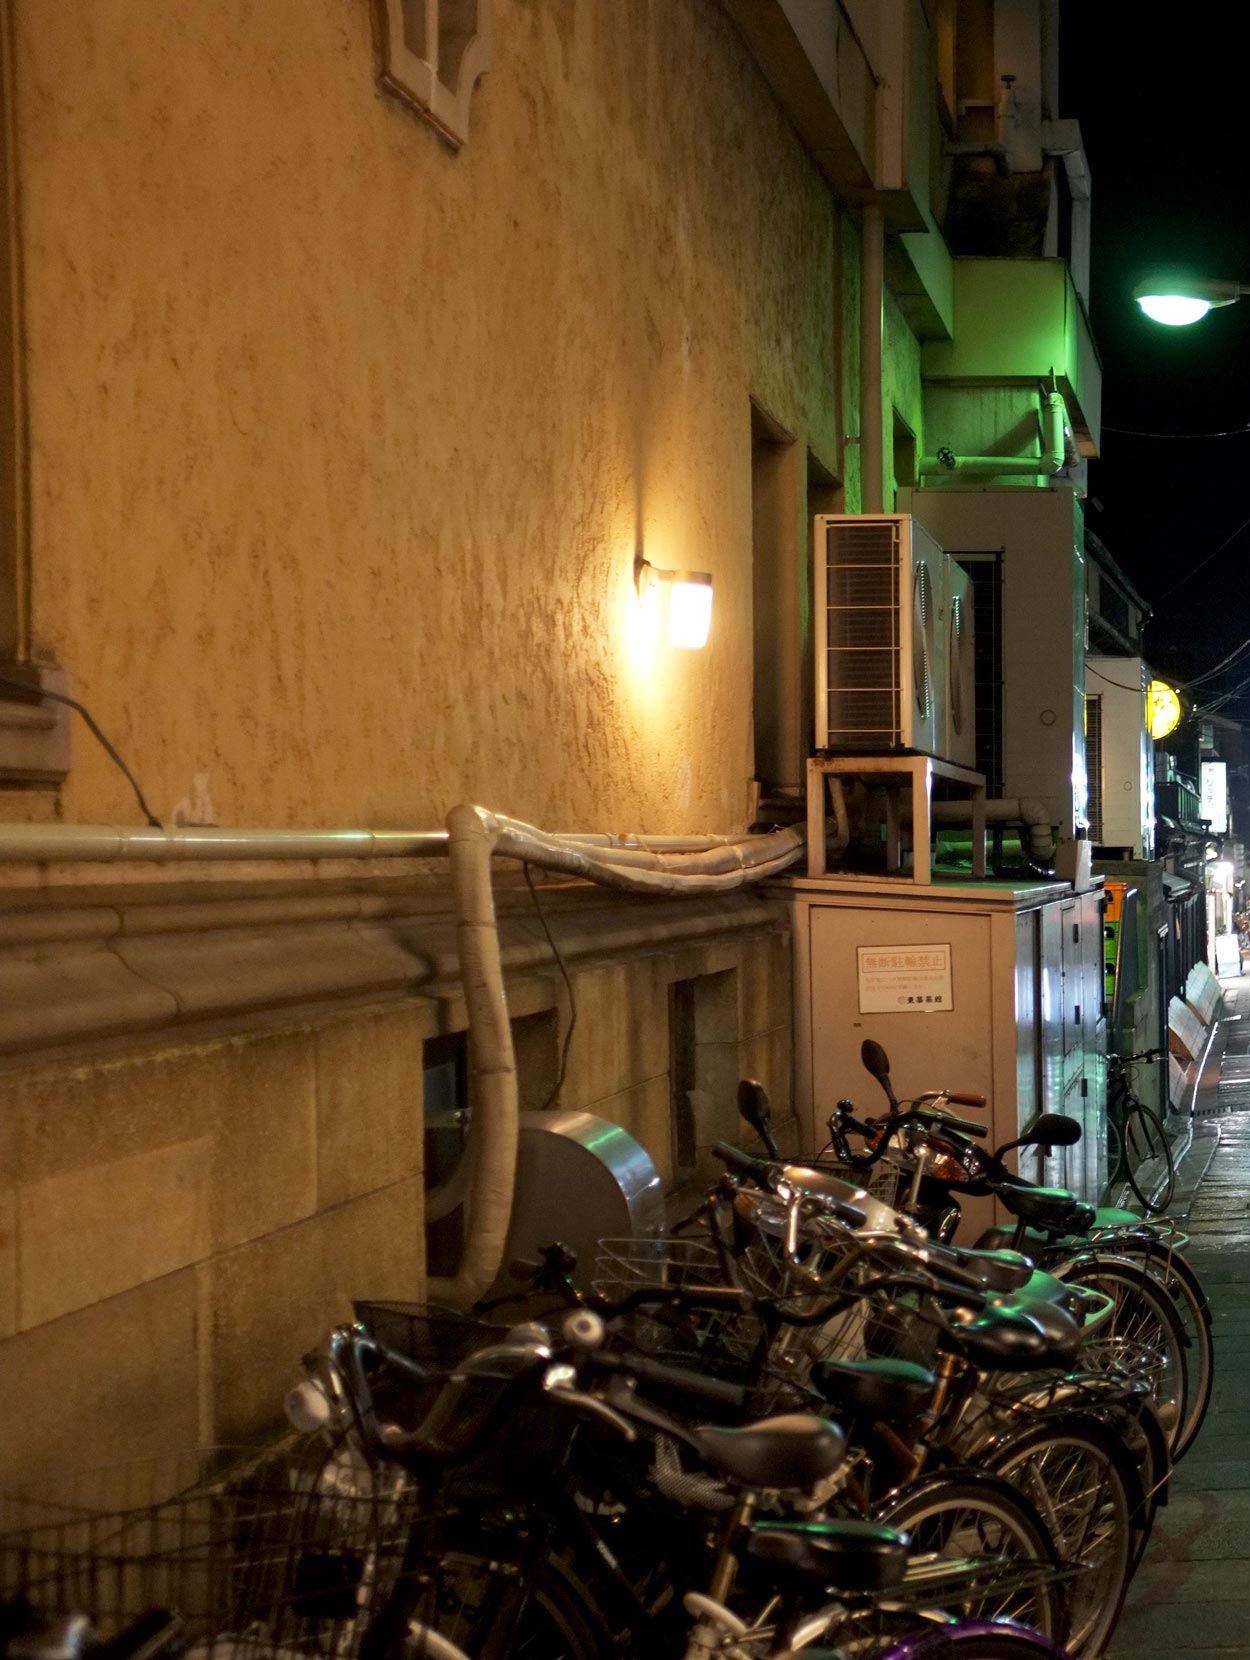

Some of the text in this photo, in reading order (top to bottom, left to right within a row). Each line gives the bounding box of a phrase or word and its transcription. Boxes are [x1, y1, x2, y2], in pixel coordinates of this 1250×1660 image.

[866, 956, 942, 969] 無断駐輪禁止
